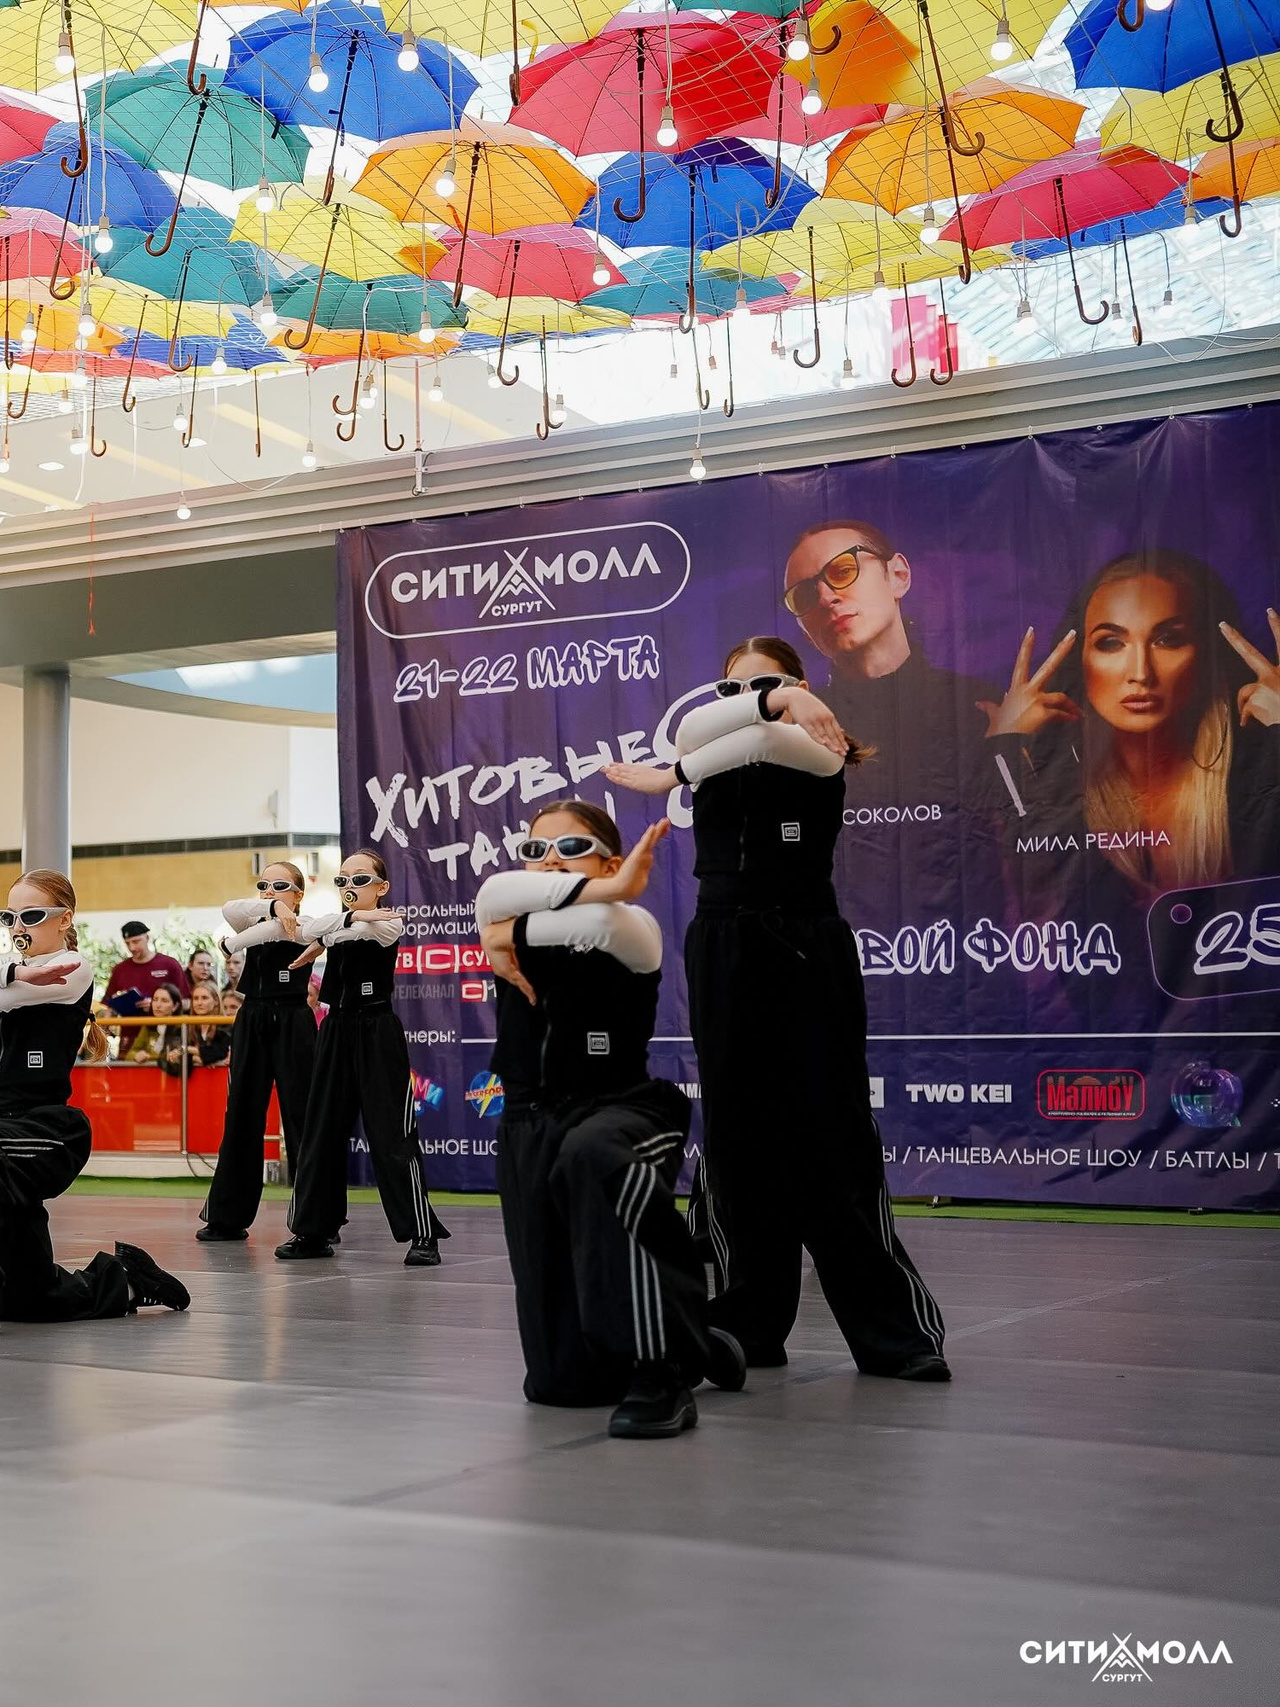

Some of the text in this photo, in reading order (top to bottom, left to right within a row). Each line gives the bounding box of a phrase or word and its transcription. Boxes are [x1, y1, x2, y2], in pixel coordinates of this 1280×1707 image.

[391, 543, 661, 603] СИТИ МОЛЛ
[491, 601, 543, 617] СУРГУТ
[393, 635, 660, 703] 21-22 МАРТА
[842, 804, 942, 826] СОКОЛОВ
[1016, 830, 1171, 854] МИЛА РЕДИНА
[963, 917, 1121, 976] ФОНД
[906, 1084, 1012, 1103] TWO KEI
[917, 1146, 1080, 1166] ТАНЦЕВАЛЬНОЕ
[1087, 1149, 1142, 1167] ШОУ
[1166, 1151, 1249, 1169] БАТТЛЫ
